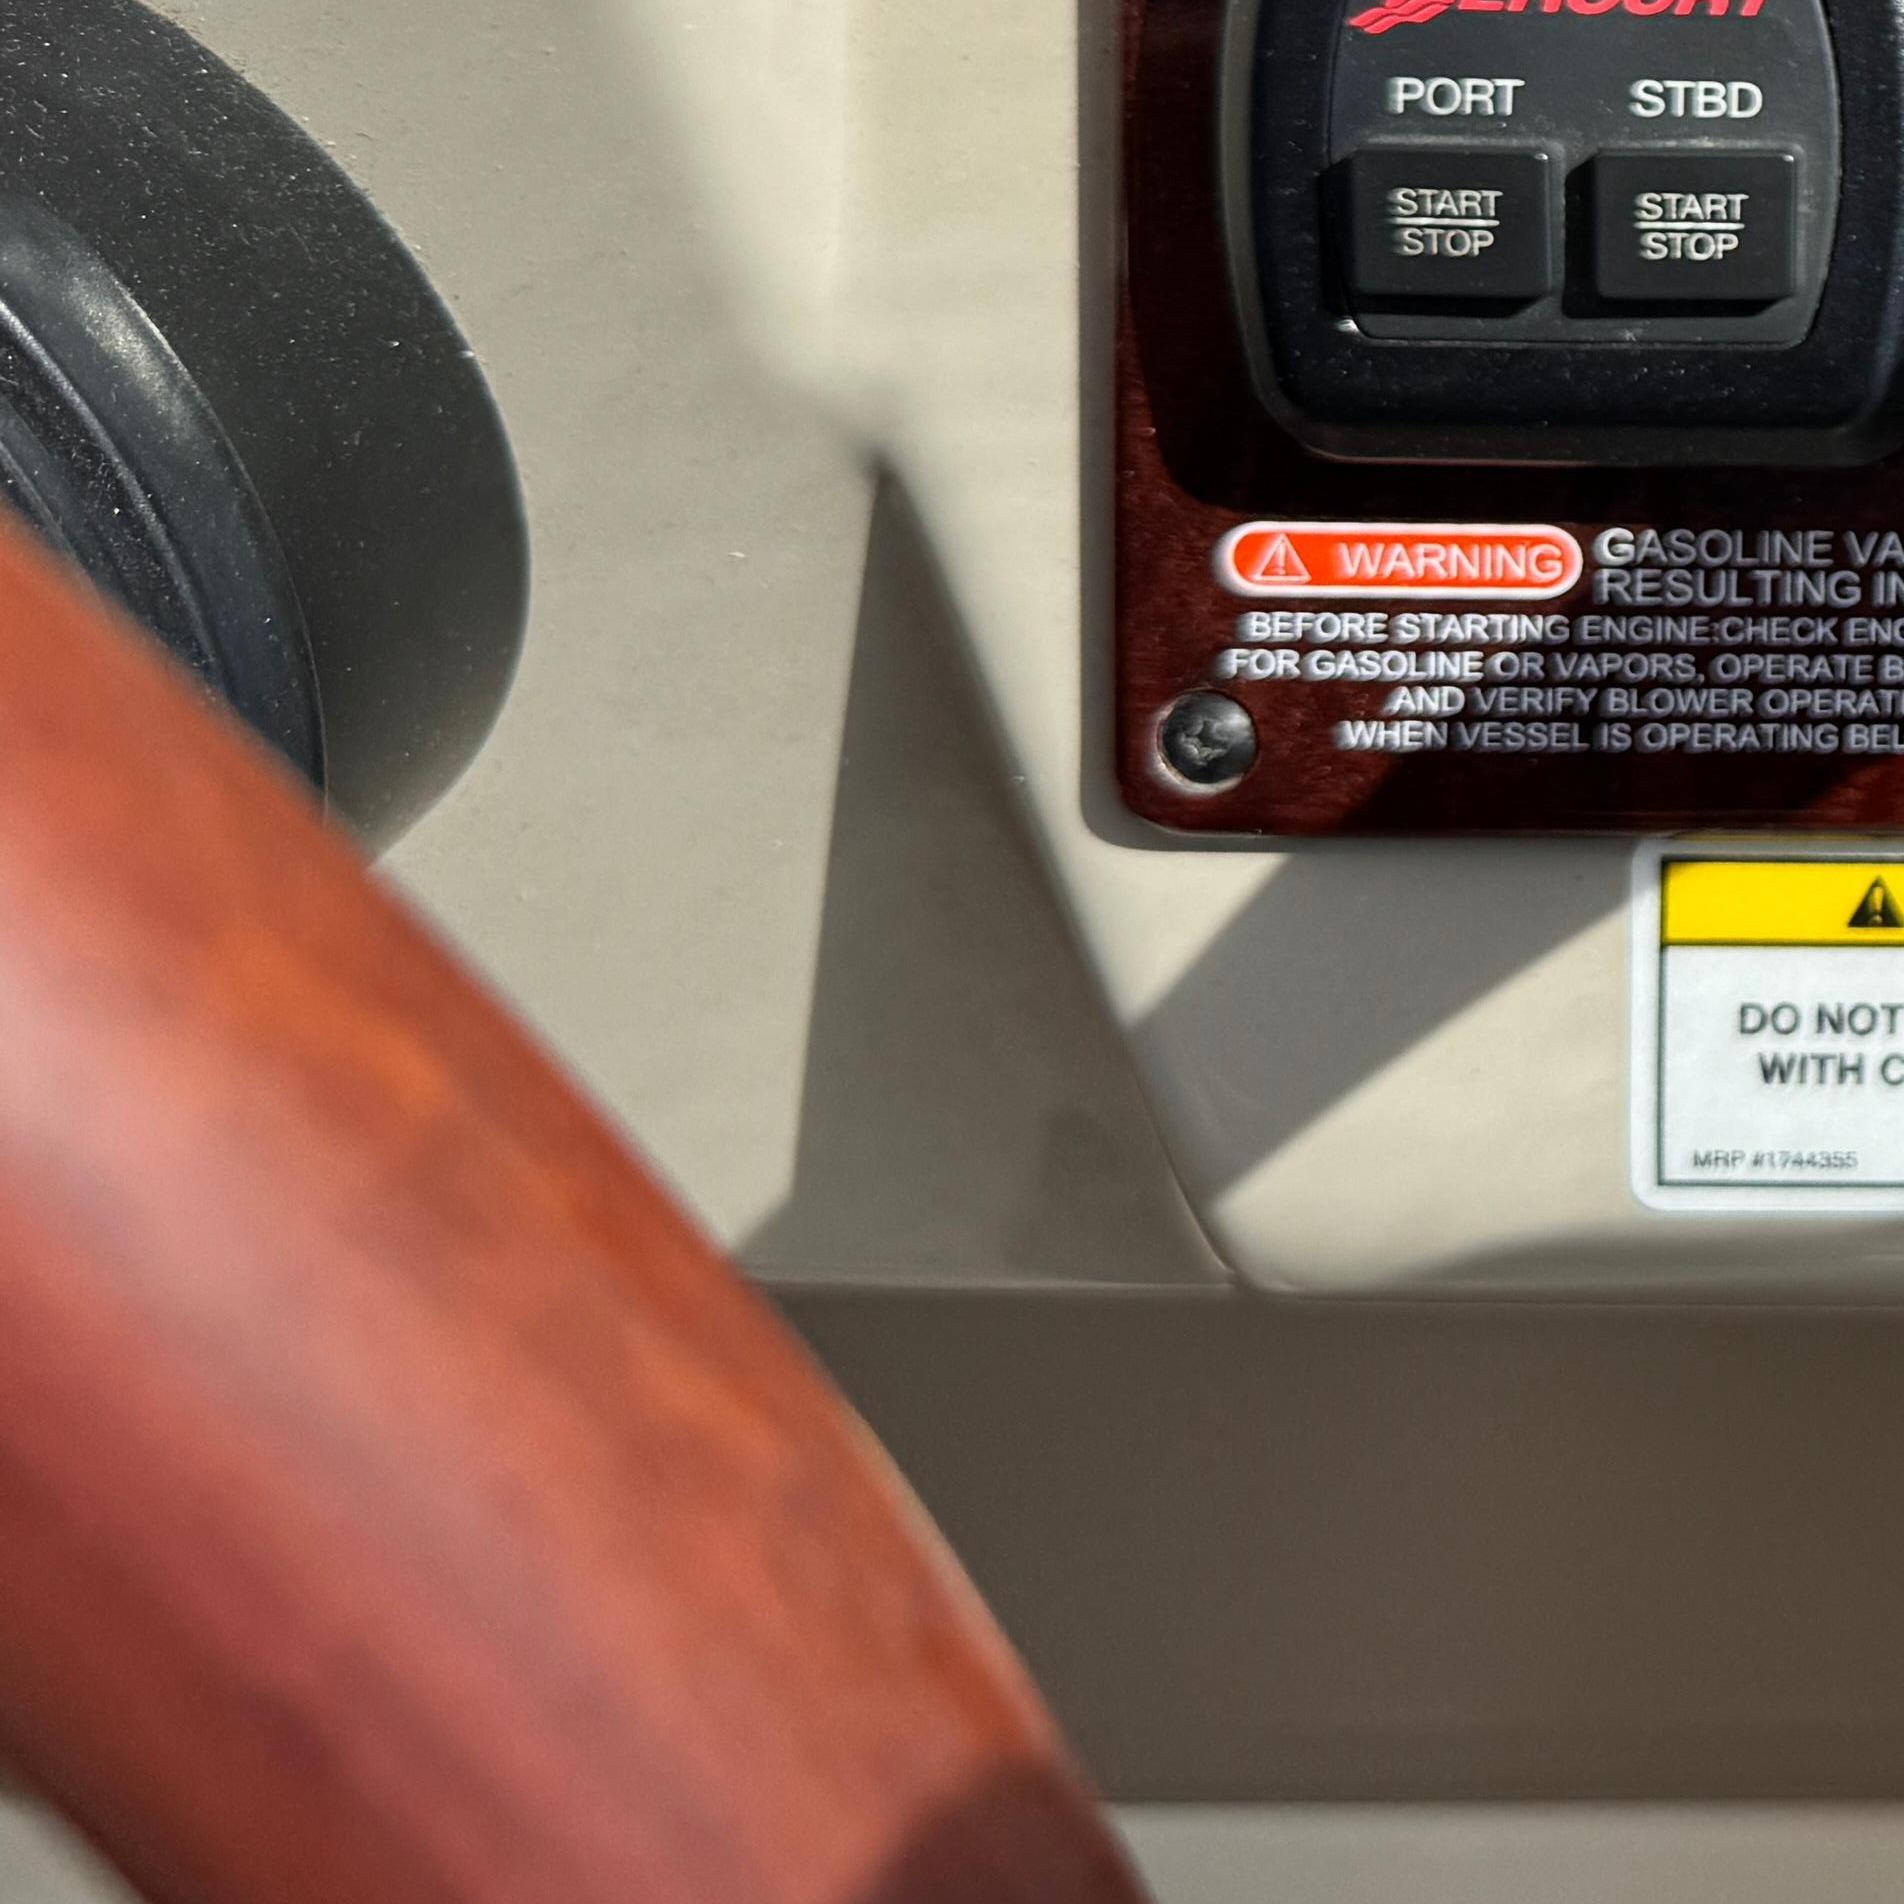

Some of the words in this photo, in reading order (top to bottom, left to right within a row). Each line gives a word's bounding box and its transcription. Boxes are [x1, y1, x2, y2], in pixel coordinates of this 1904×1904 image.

[1387, 76, 1525, 115] PORT
[1630, 79, 1762, 119] STBD
[1387, 188, 1503, 217] START
[1633, 193, 1748, 221] START
[1397, 229, 1494, 256] STOP
[1640, 233, 1738, 260] STOP
[1335, 542, 1563, 580] WARNING
[1594, 528, 1834, 567] GASOLINE
[1595, 569, 1861, 607] RESULTING
[1239, 612, 1388, 643] BEFORE
[1391, 613, 1570, 644] STARTING
[1219, 648, 1300, 680] FOR
[1302, 649, 1483, 681] GASOLINE
[1485, 651, 1545, 682] OR
[1709, 653, 1873, 684] OPERATE
[1381, 687, 1465, 717] AND
[1467, 687, 1596, 717] VERIFY
[1601, 687, 1753, 718] BLOWER
[1333, 721, 1447, 751] WHEN
[1450, 721, 1590, 752] VESSEL
[1600, 722, 1633, 752] IS
[1638, 722, 1838, 754] OPERATING
[1737, 1002, 1798, 1036] DO
[1756, 1053, 1864, 1087] WITH
